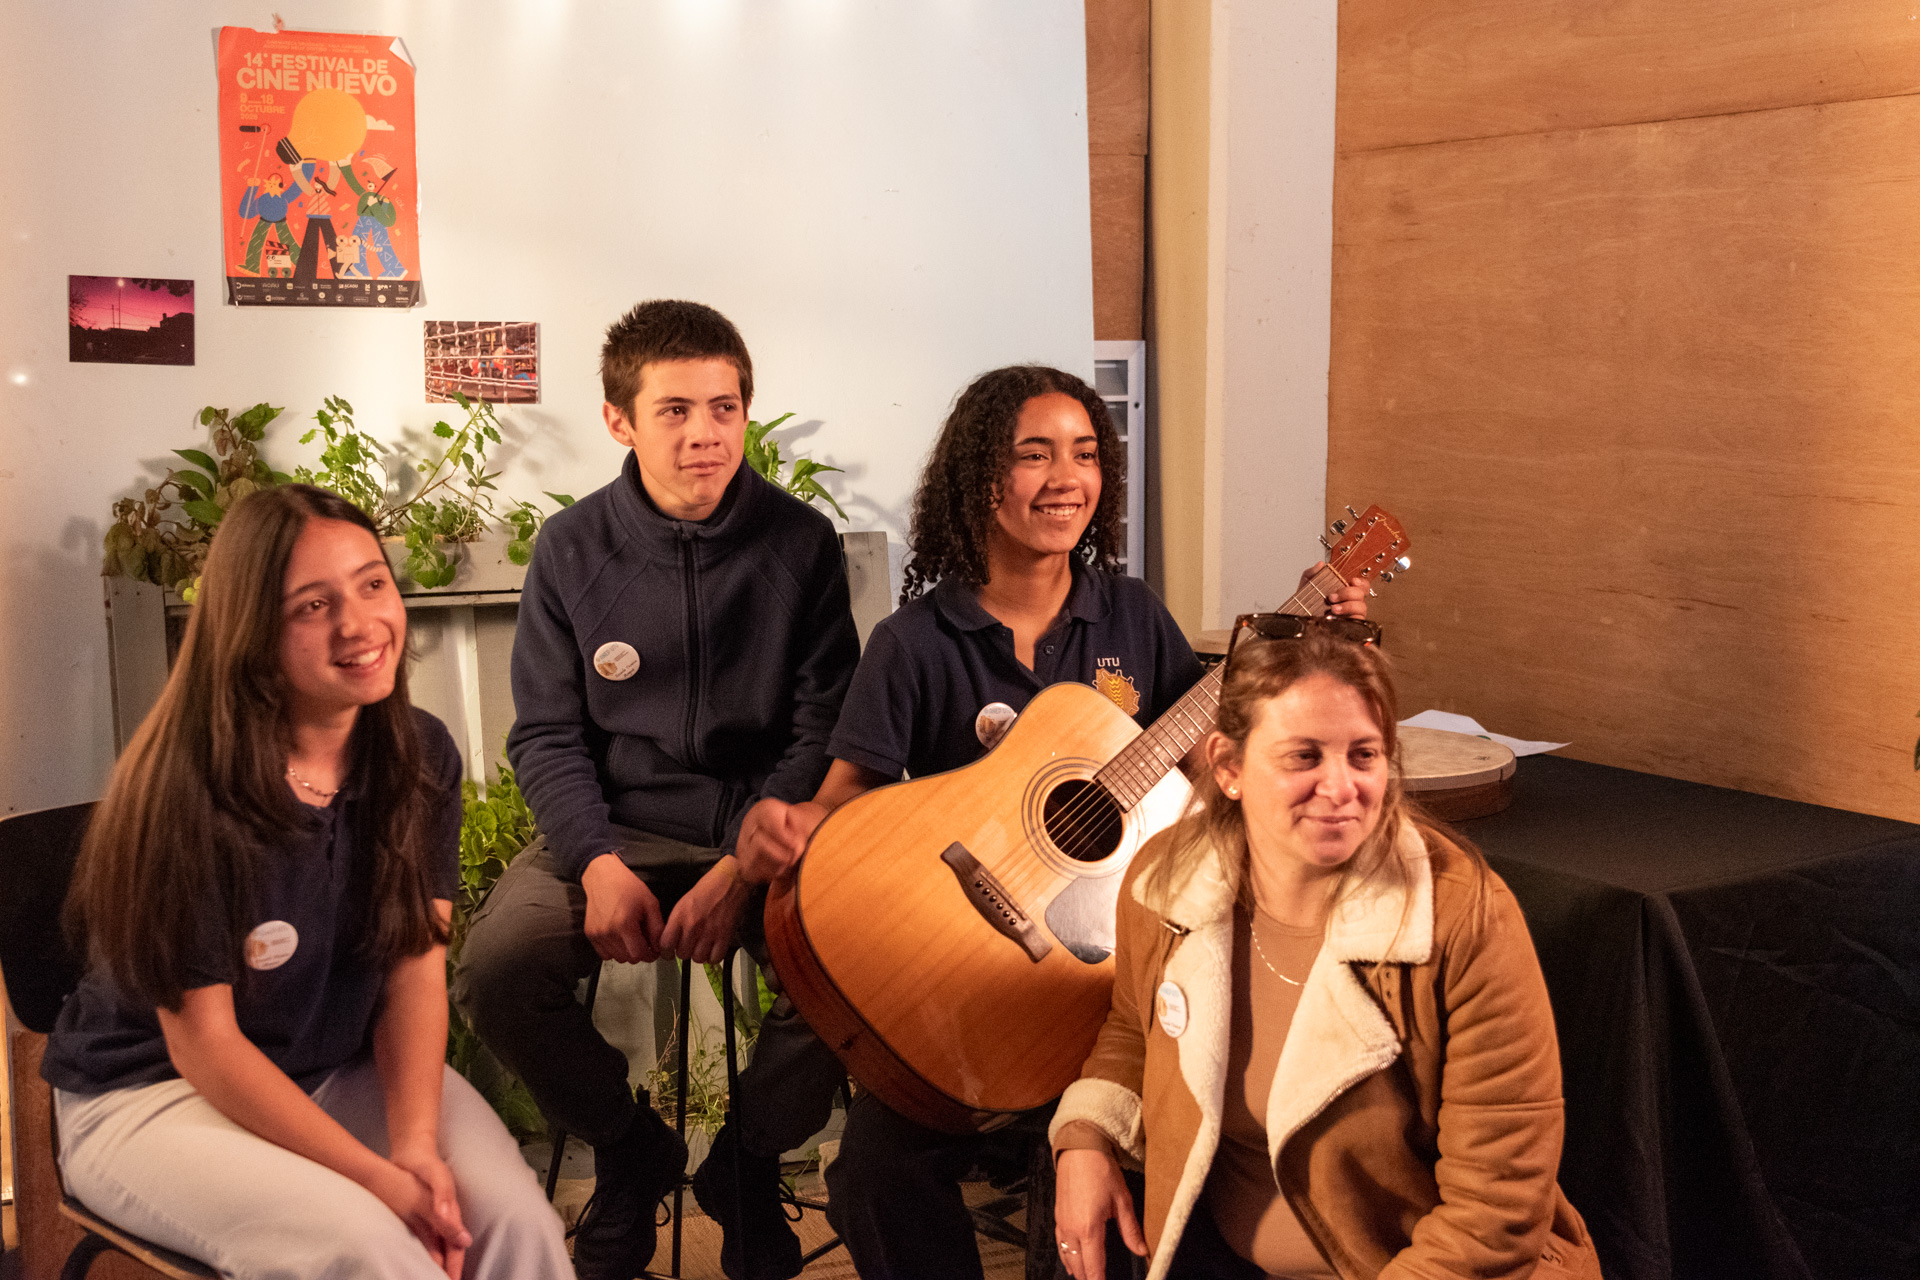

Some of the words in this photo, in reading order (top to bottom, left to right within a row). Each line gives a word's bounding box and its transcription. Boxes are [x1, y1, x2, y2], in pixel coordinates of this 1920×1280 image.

[271, 53, 360, 73] FESTIVAL
[363, 58, 389, 74] DE
[236, 67, 300, 91] CINE
[306, 70, 397, 96] NUEVO
[240, 104, 286, 114] OCTUBRE
[1096, 656, 1120, 667] UTU
